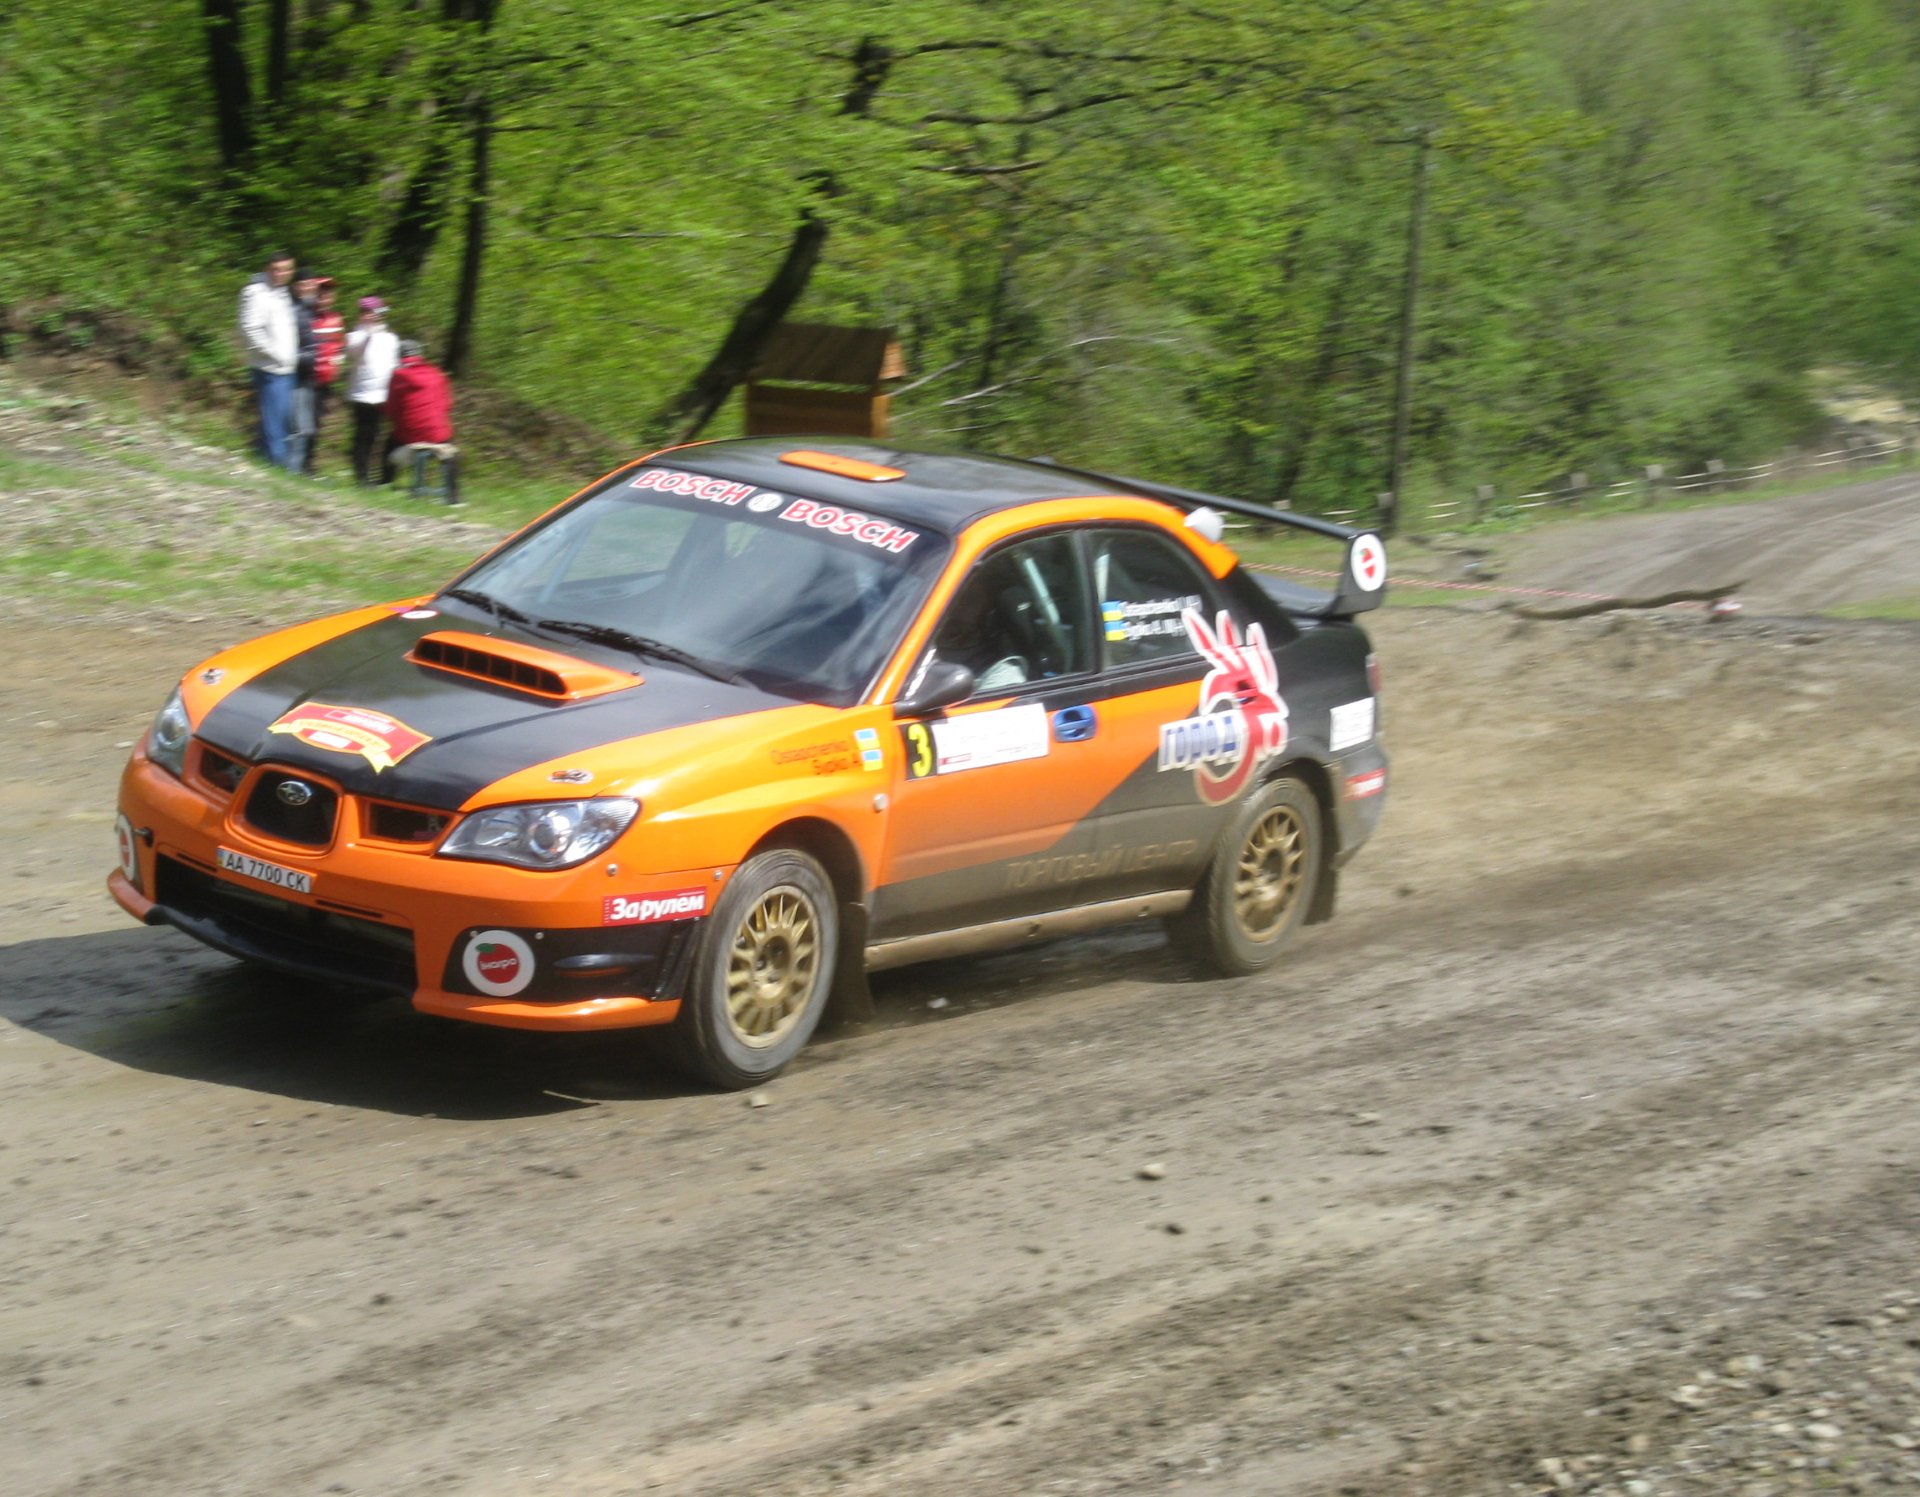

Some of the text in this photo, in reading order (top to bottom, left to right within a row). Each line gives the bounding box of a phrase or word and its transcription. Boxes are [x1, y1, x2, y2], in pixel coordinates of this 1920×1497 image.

[630, 470, 919, 553] BOSCH BOSCH
[907, 723, 933, 777] 3
[226, 853, 307, 892] AA 7700 CK
